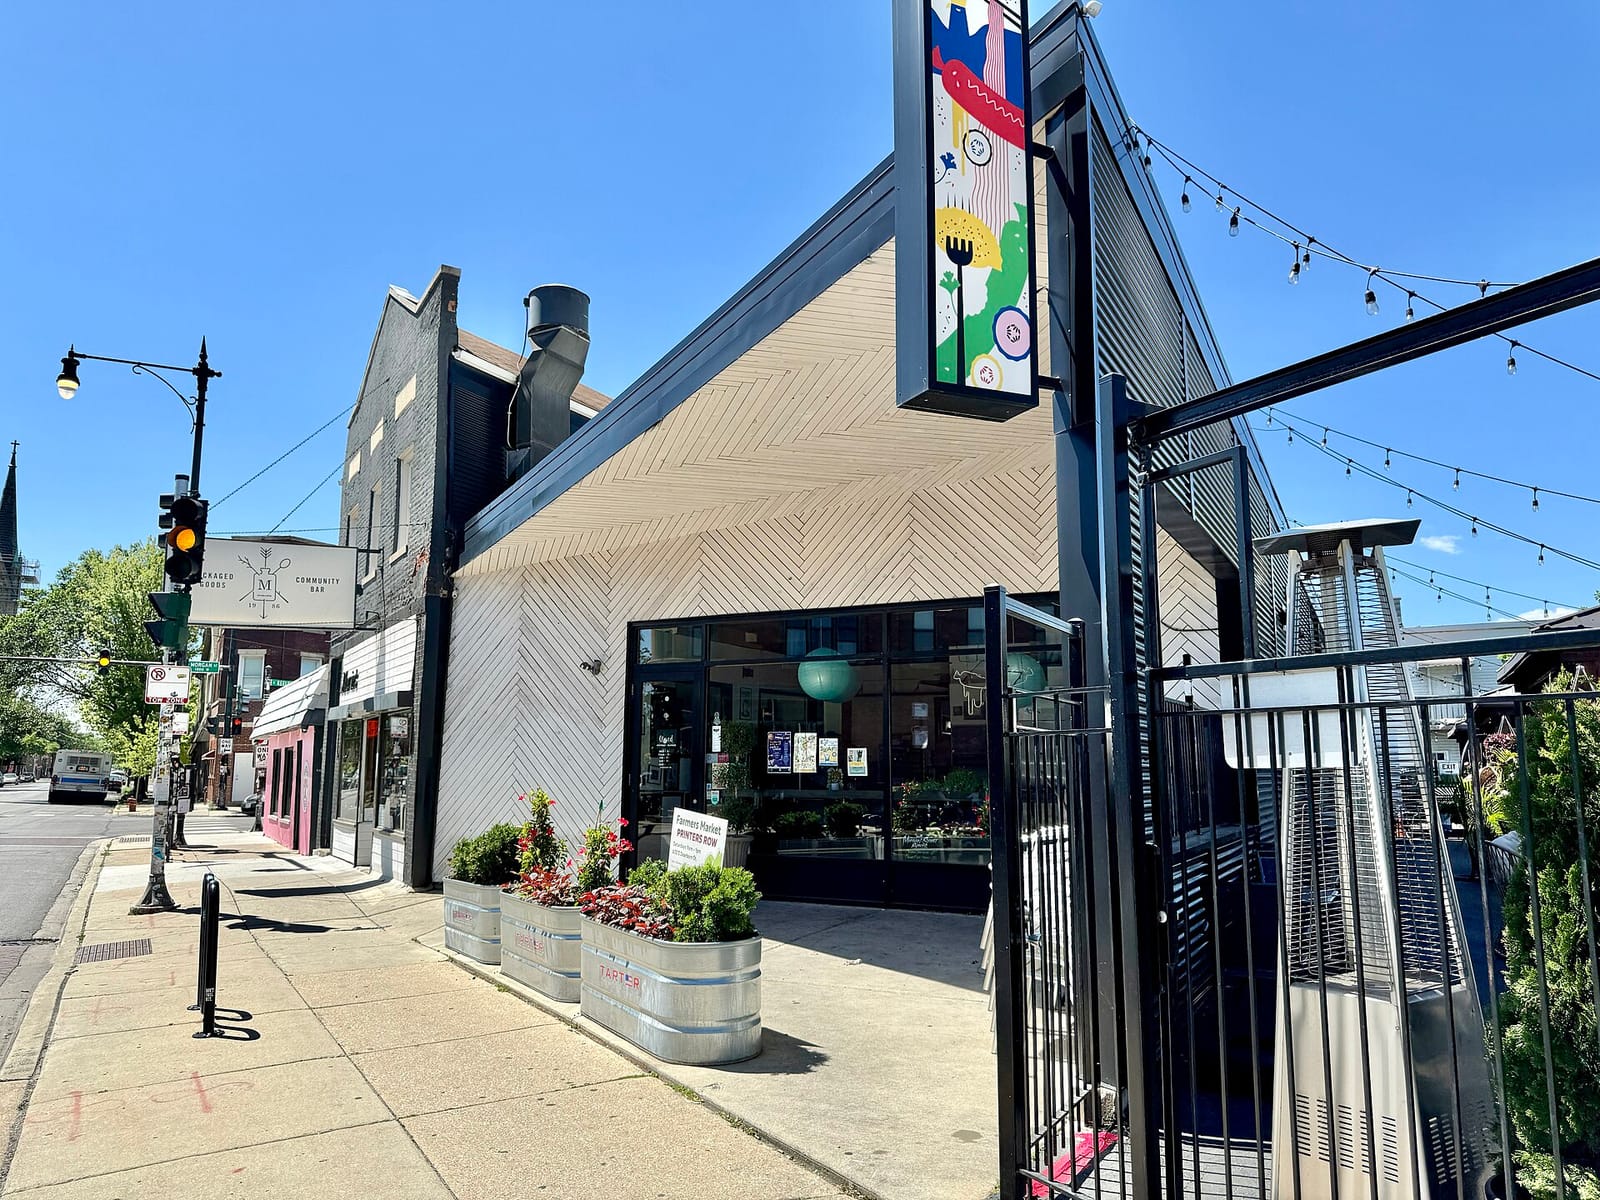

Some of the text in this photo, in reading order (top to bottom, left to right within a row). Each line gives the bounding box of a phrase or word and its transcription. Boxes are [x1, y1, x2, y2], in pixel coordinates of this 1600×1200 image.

[201, 572, 235, 580] CKAGED
[295, 576, 341, 585] COMMUNITY
[199, 580, 227, 589] GOODS
[258, 579, 272, 591] M
[676, 814, 722, 836] Farmers Market
[676, 828, 719, 848] PRINTERS ROW
[600, 965, 641, 991] TARTER
